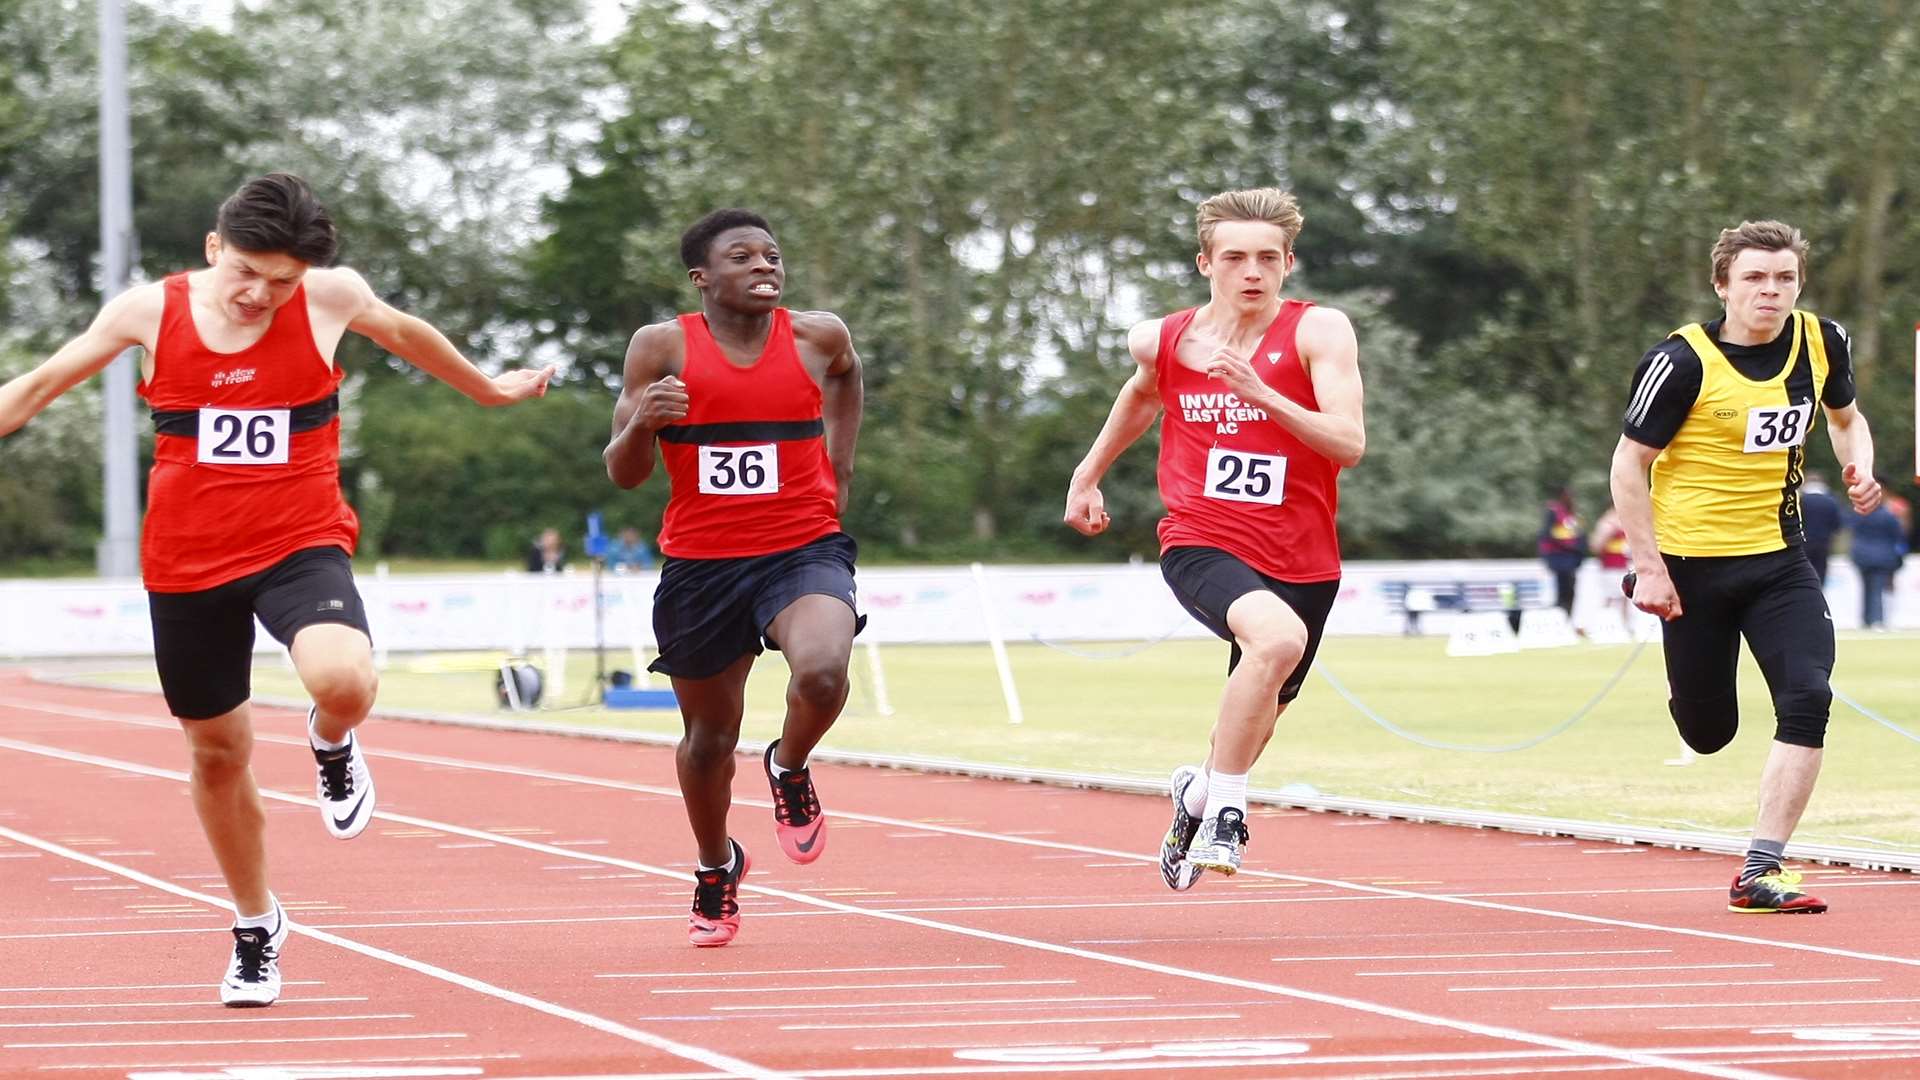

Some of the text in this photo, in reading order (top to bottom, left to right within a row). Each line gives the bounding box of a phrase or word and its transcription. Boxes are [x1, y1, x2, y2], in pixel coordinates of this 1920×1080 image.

[1179, 393, 1256, 409] INVIC
[1183, 408, 1269, 423] EAST KENT
[211, 414, 276, 458] 26
[1216, 422, 1239, 435] AC
[1754, 409, 1801, 447] 38
[709, 450, 766, 489] 36
[1215, 455, 1272, 497] 25
